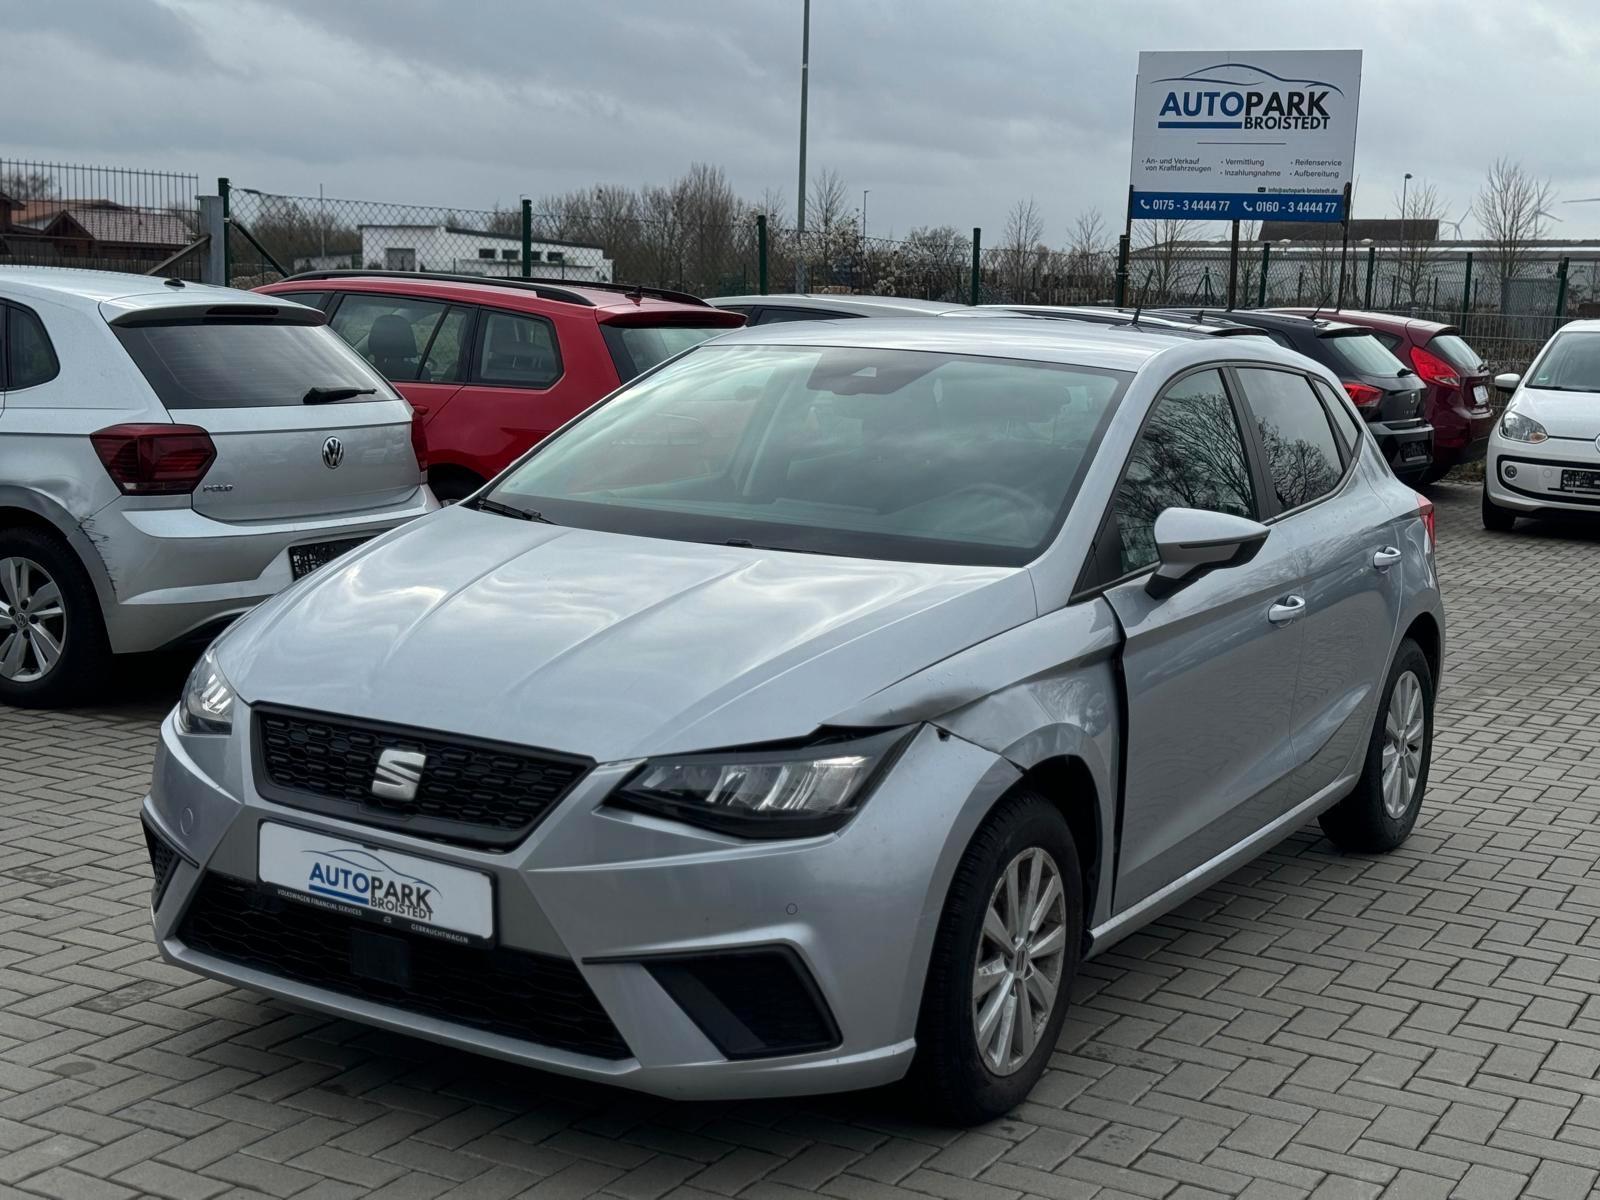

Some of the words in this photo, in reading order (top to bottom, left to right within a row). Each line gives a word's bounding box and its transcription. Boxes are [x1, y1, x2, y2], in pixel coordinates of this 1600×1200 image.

[1159, 91, 1330, 116] AUTOPARK
[1244, 116, 1331, 130] BROISTEDT
[1225, 158, 1265, 167] Vermittlung
[1159, 165, 1212, 173] Kraftfahrzeugen
[1224, 169, 1281, 178] Inzahlungnahme
[1293, 170, 1340, 179] Aufbereitung
[1152, 199, 1175, 210] 0175
[1255, 201, 1280, 212] 0160
[202, 484, 233, 493] POLO
[309, 862, 434, 914] AUTOPARK
[277, 888, 311, 903] VOLKSWAGEN
[311, 898, 338, 910] FINANCIAL
[338, 905, 362, 916] SERVICES
[370, 897, 433, 921] BROISTEDT
[410, 923, 469, 944] GEBRAUCHTWAGEN
